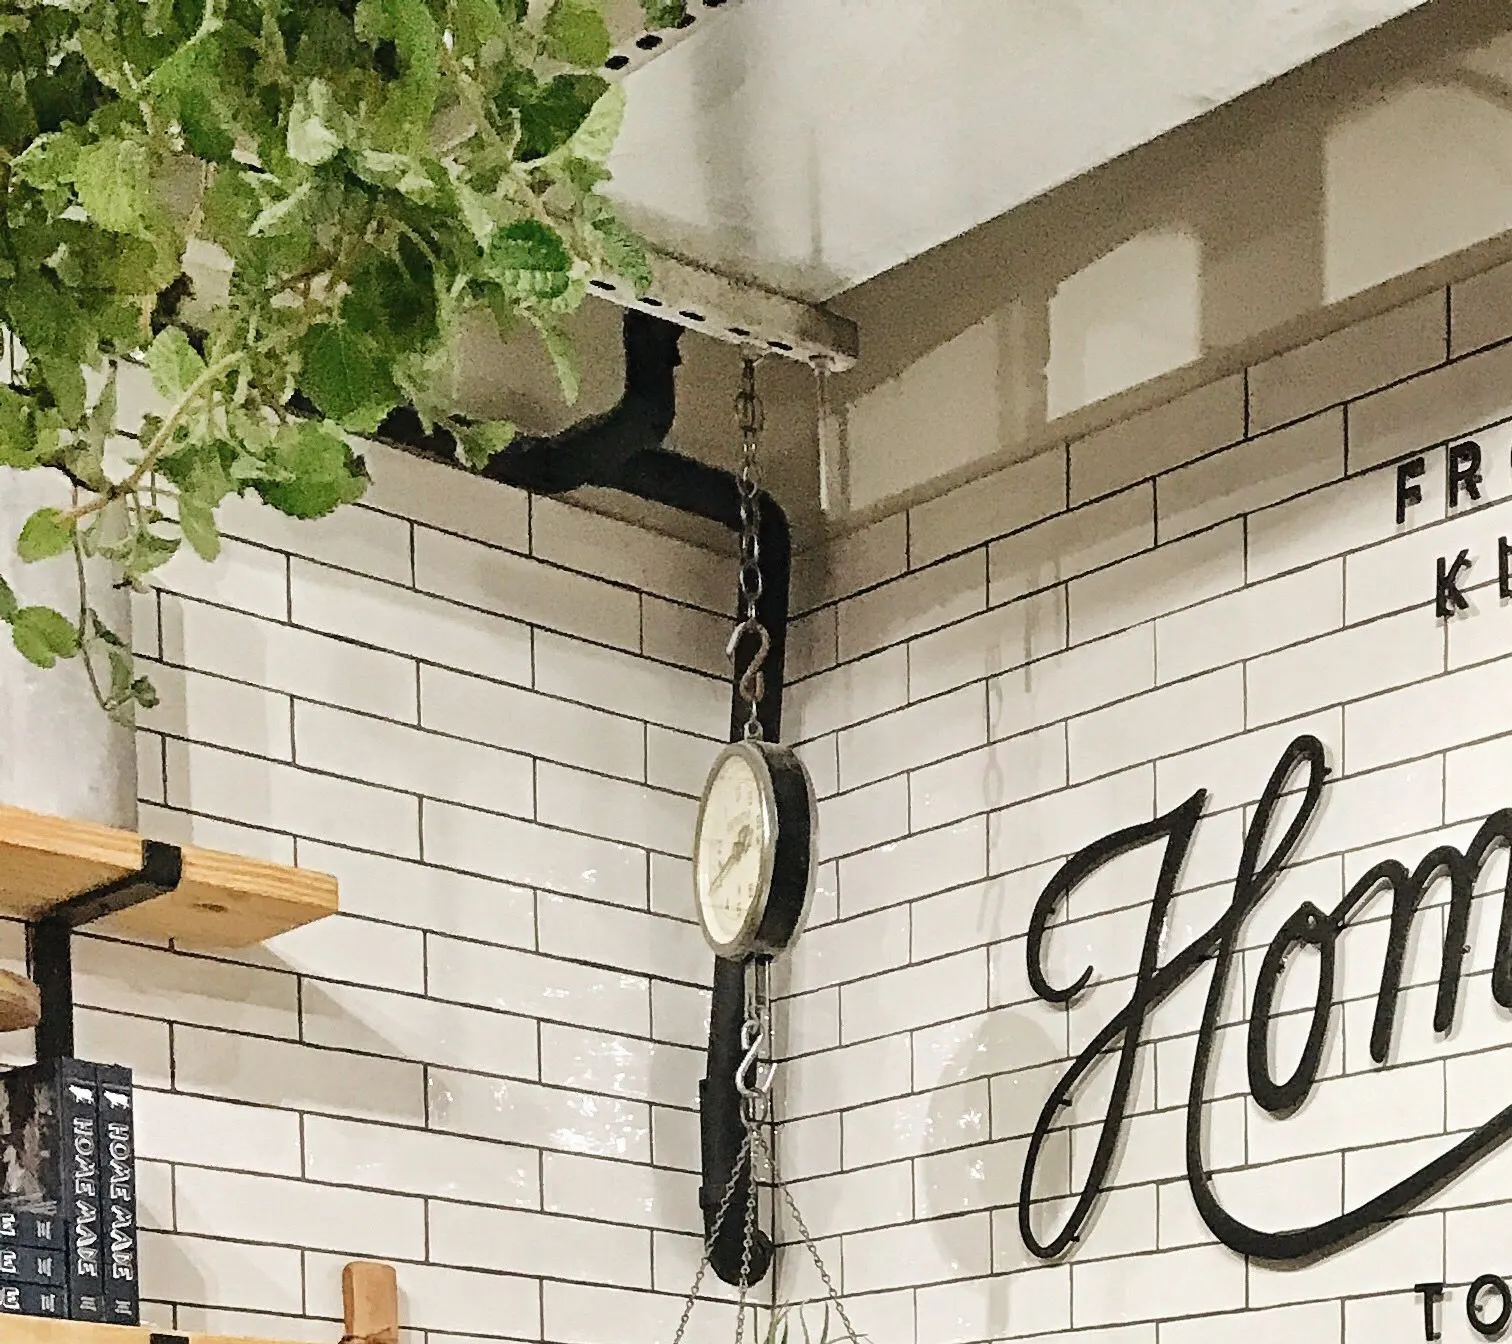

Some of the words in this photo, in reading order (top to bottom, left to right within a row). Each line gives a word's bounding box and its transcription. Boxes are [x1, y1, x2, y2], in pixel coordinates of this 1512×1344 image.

[73, 1116, 97, 1197] HOME
[108, 1123, 131, 1202] HOME
[75, 1200, 98, 1277] MADE
[111, 1205, 133, 1281] MADE
